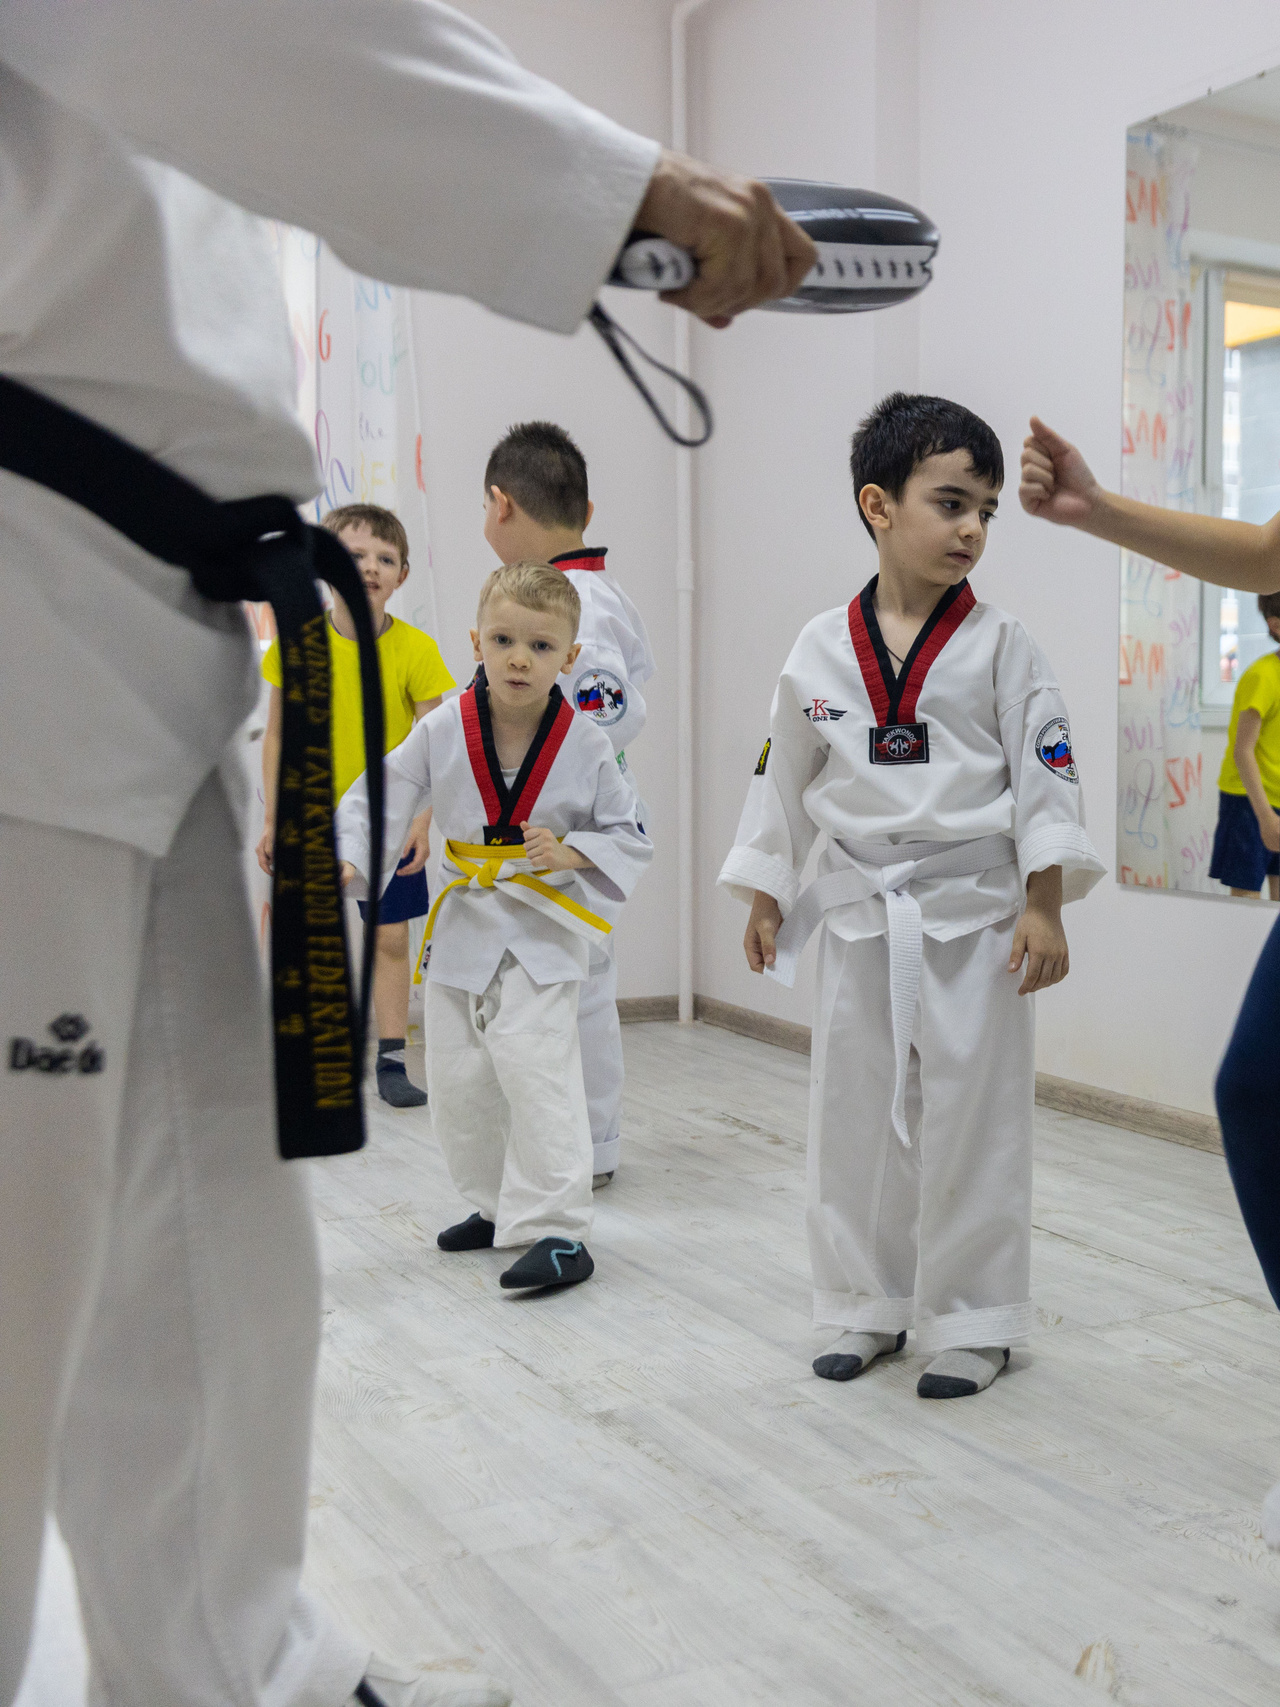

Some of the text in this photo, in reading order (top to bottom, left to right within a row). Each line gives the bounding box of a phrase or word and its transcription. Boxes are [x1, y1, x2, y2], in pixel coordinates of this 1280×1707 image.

[811, 698, 830, 717] K
[881, 727, 918, 745] TAEKWONDO
[303, 745, 340, 925] TAEKWONDO
[306, 935, 353, 1109] FEDERATION
